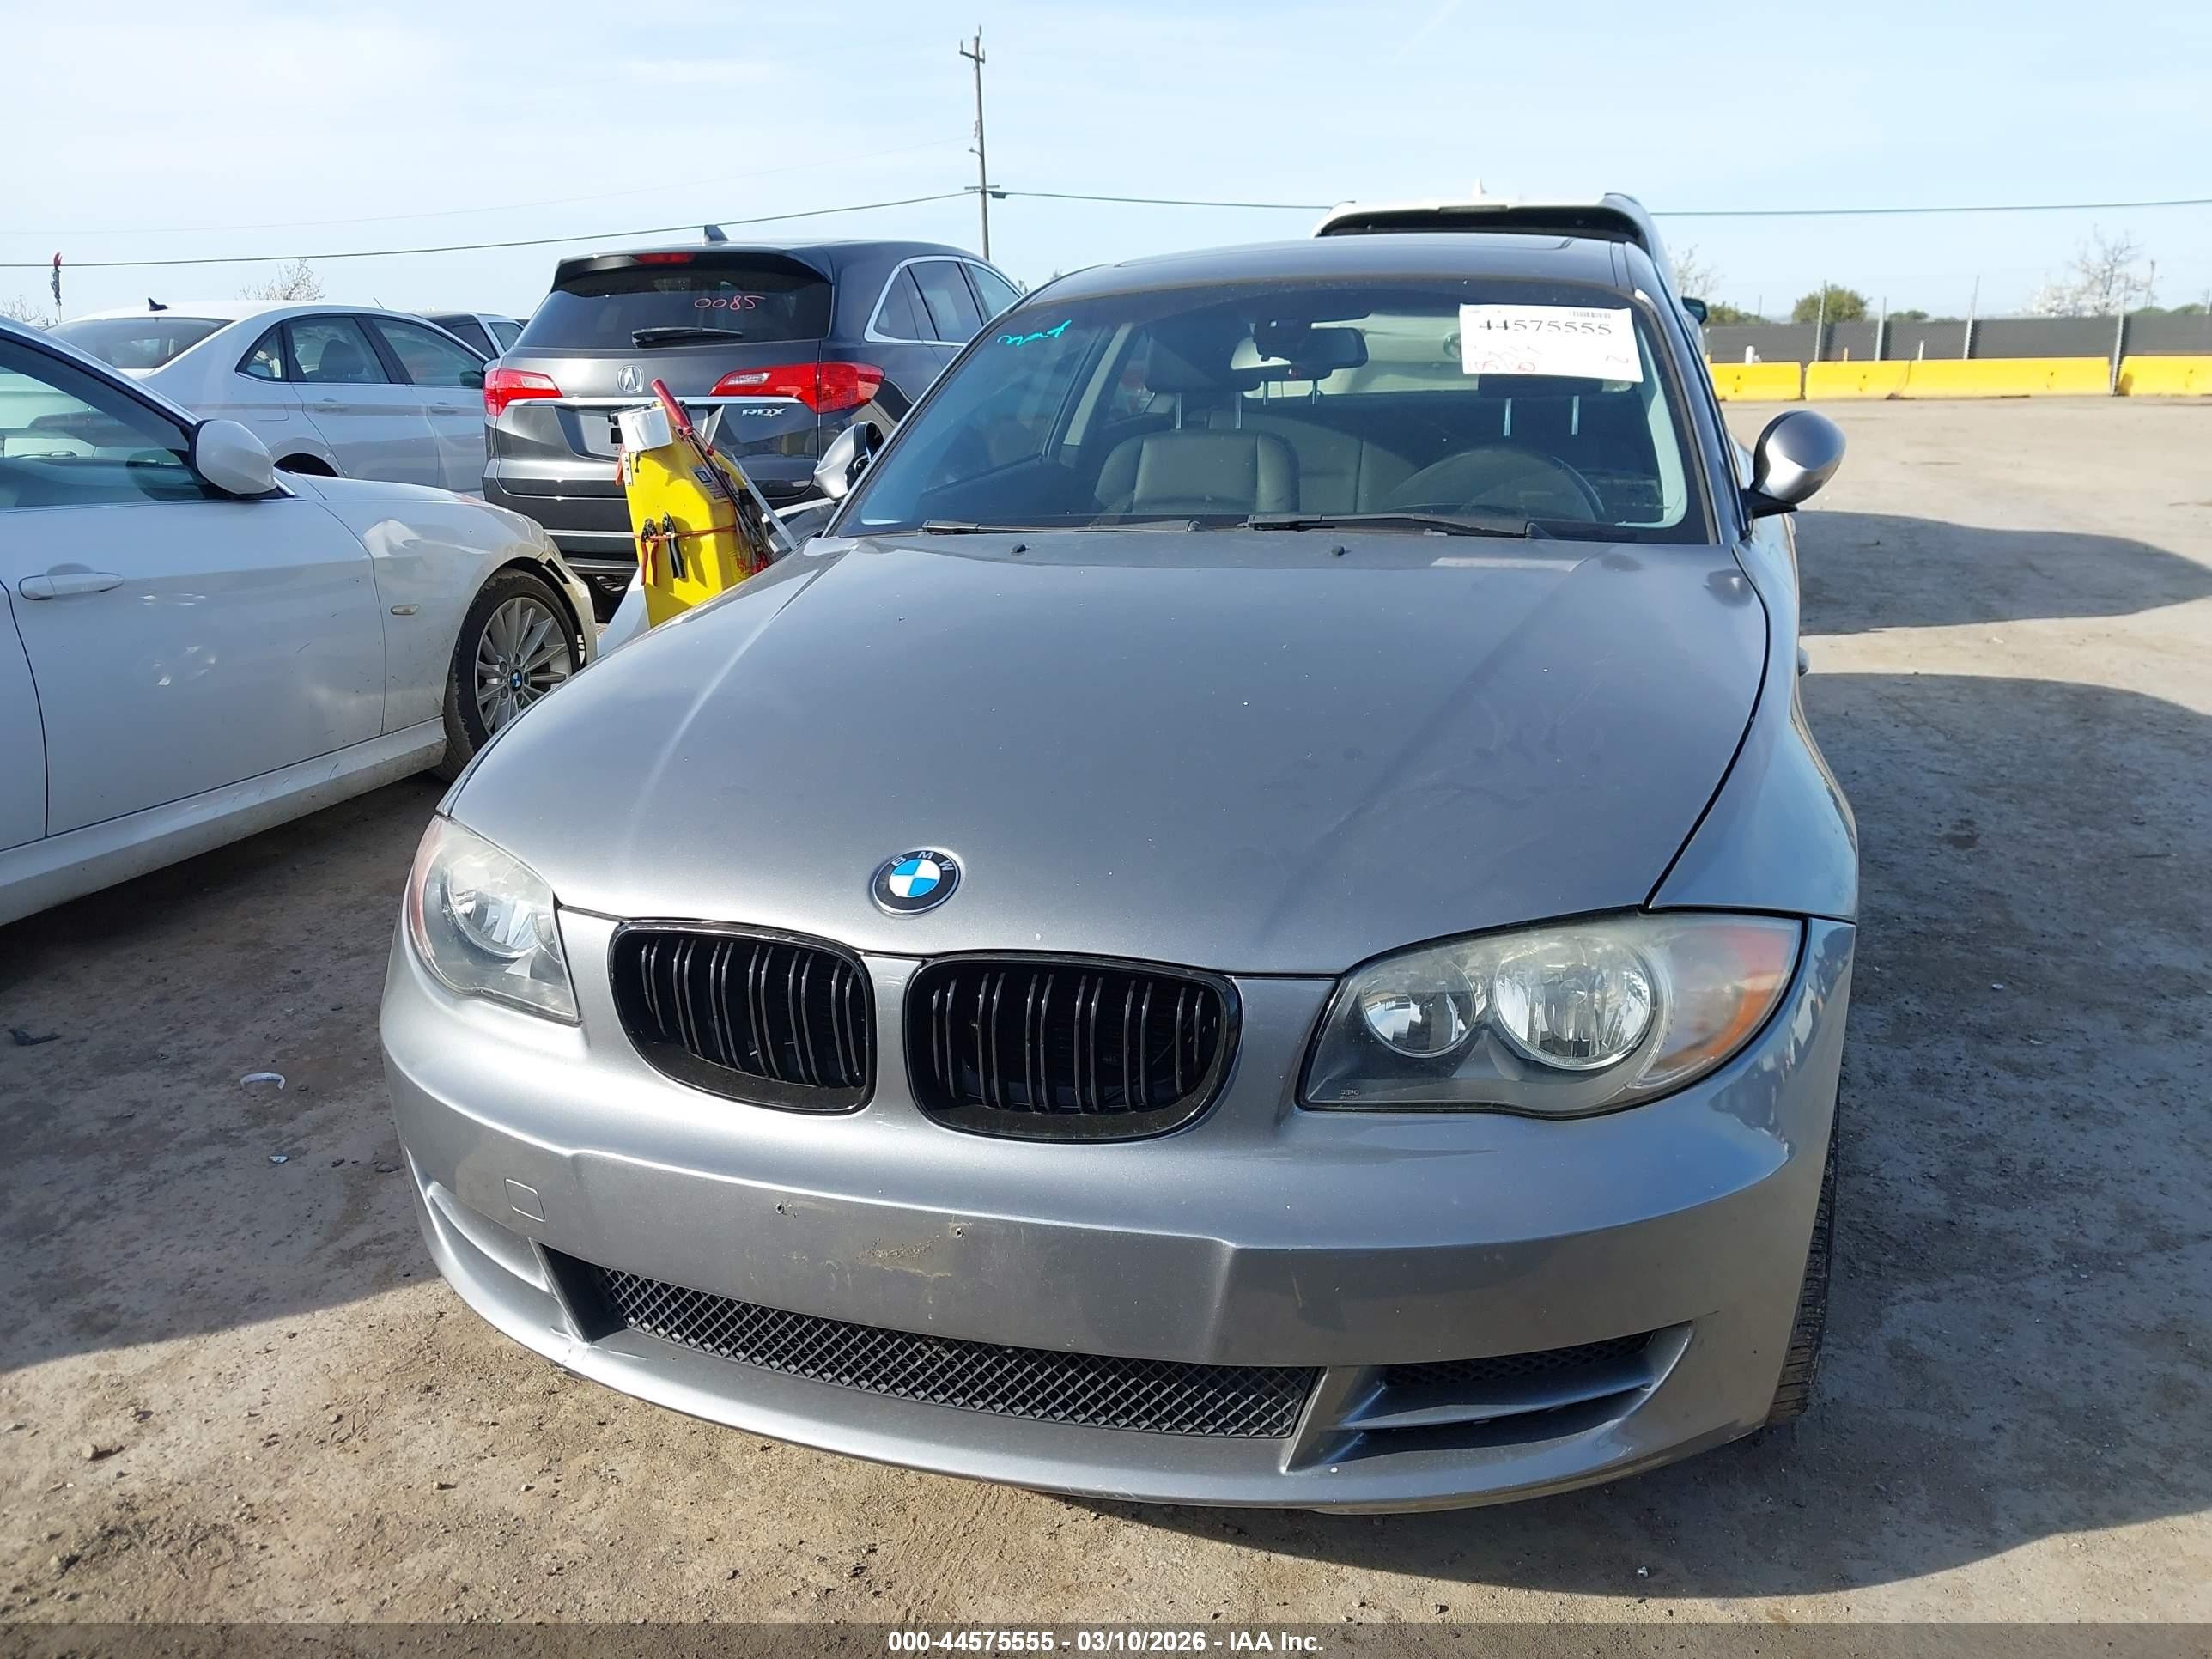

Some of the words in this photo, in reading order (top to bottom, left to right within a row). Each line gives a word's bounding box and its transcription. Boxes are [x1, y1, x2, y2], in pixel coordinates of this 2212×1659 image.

[694, 295, 765, 310] 0085
[1480, 319, 1612, 335] 44575555
[741, 408, 786, 417] RDX
[891, 852, 955, 871] BMW
